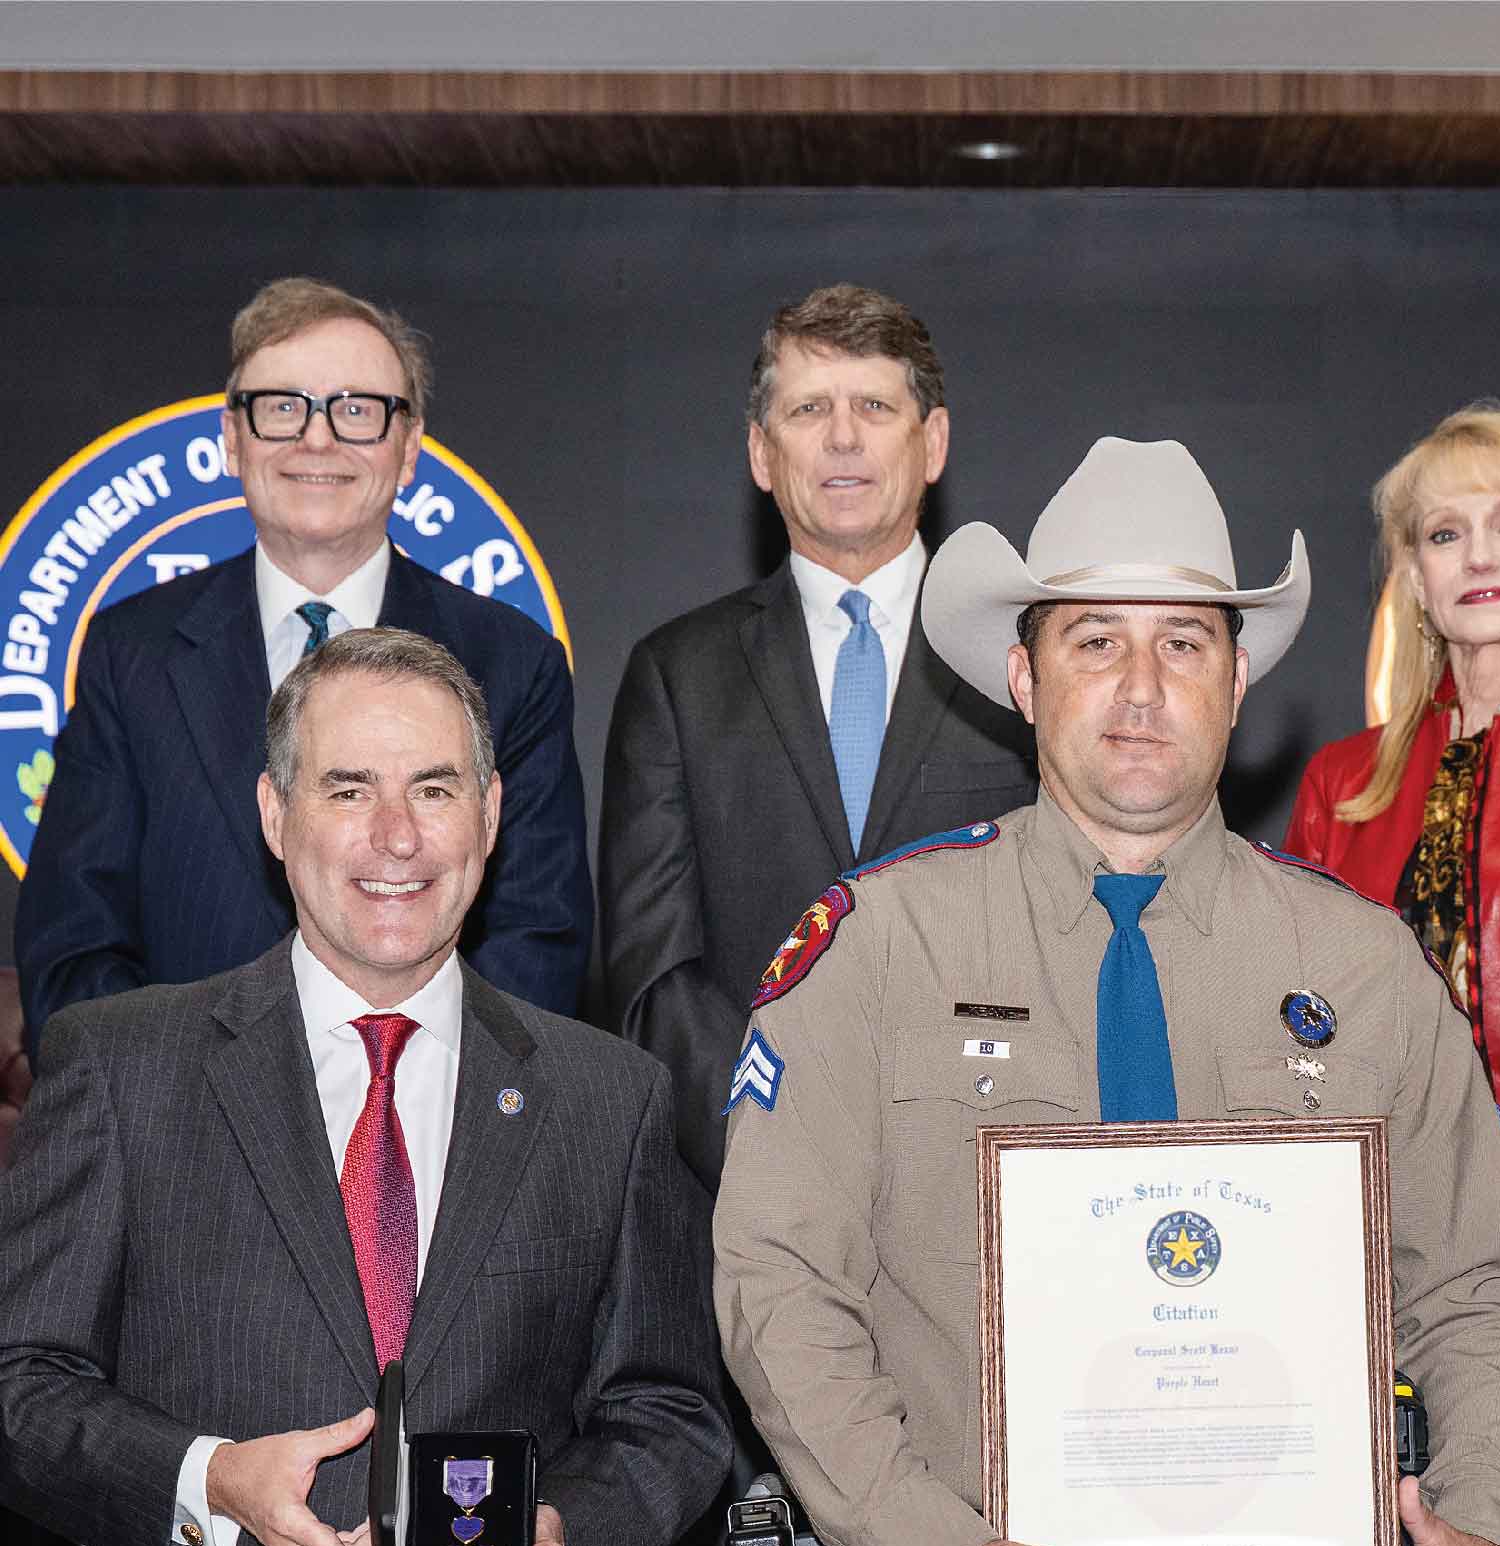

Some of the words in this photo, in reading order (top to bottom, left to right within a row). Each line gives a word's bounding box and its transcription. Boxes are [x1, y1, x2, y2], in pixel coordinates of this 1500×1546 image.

[0, 454, 171, 737] DEPARTMENT
[1090, 1195, 1123, 1218] The
[1132, 1182, 1184, 1201] State
[1193, 1180, 1212, 1199] of
[1218, 1181, 1272, 1215] Texas
[1152, 1303, 1219, 1321] Citation
